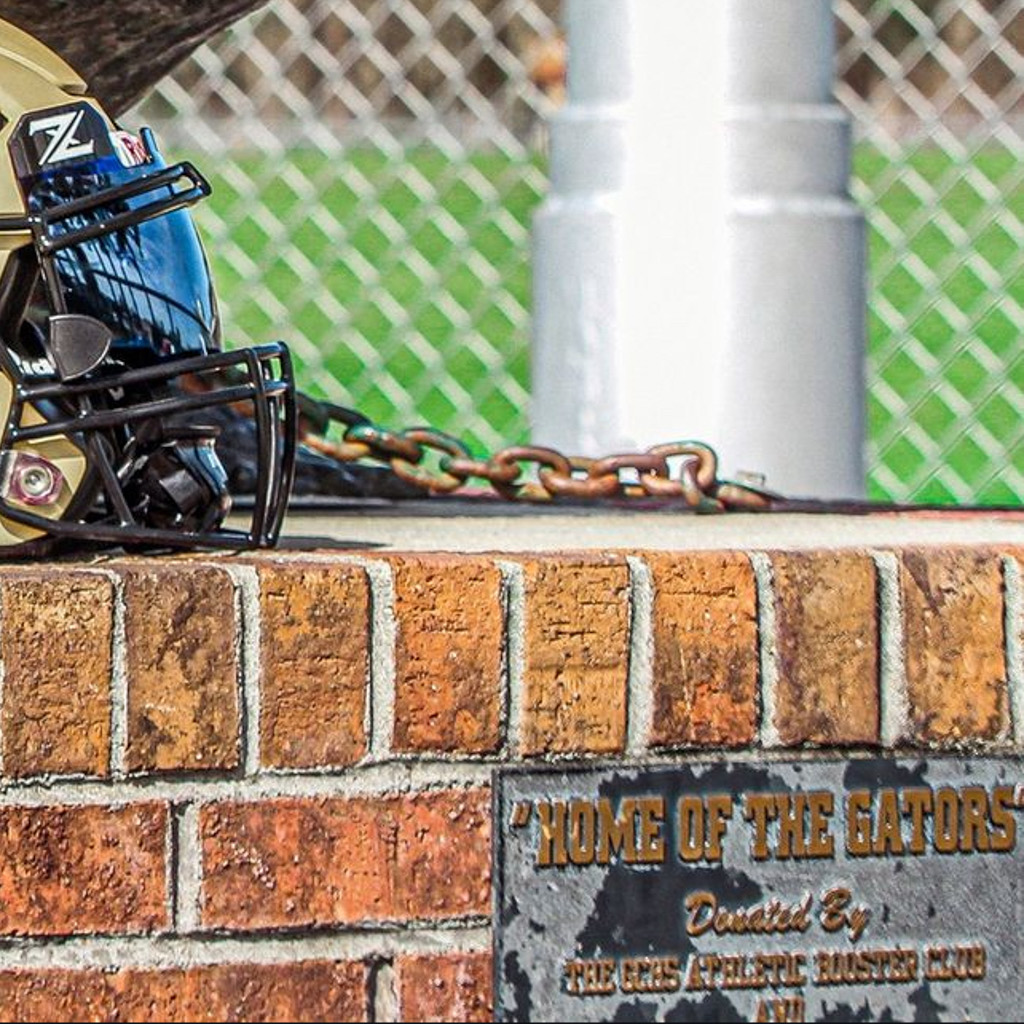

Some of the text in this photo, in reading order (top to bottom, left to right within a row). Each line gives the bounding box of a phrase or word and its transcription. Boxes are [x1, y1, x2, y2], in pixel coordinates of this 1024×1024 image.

[678, 794, 733, 862] OF
[744, 789, 834, 861] THE
[684, 886, 871, 943] Donated By
[564, 956, 616, 996] THE
[685, 949, 807, 991] ATHLETIC
[813, 947, 919, 986] BOOSTER
[922, 942, 987, 981] CLUB
